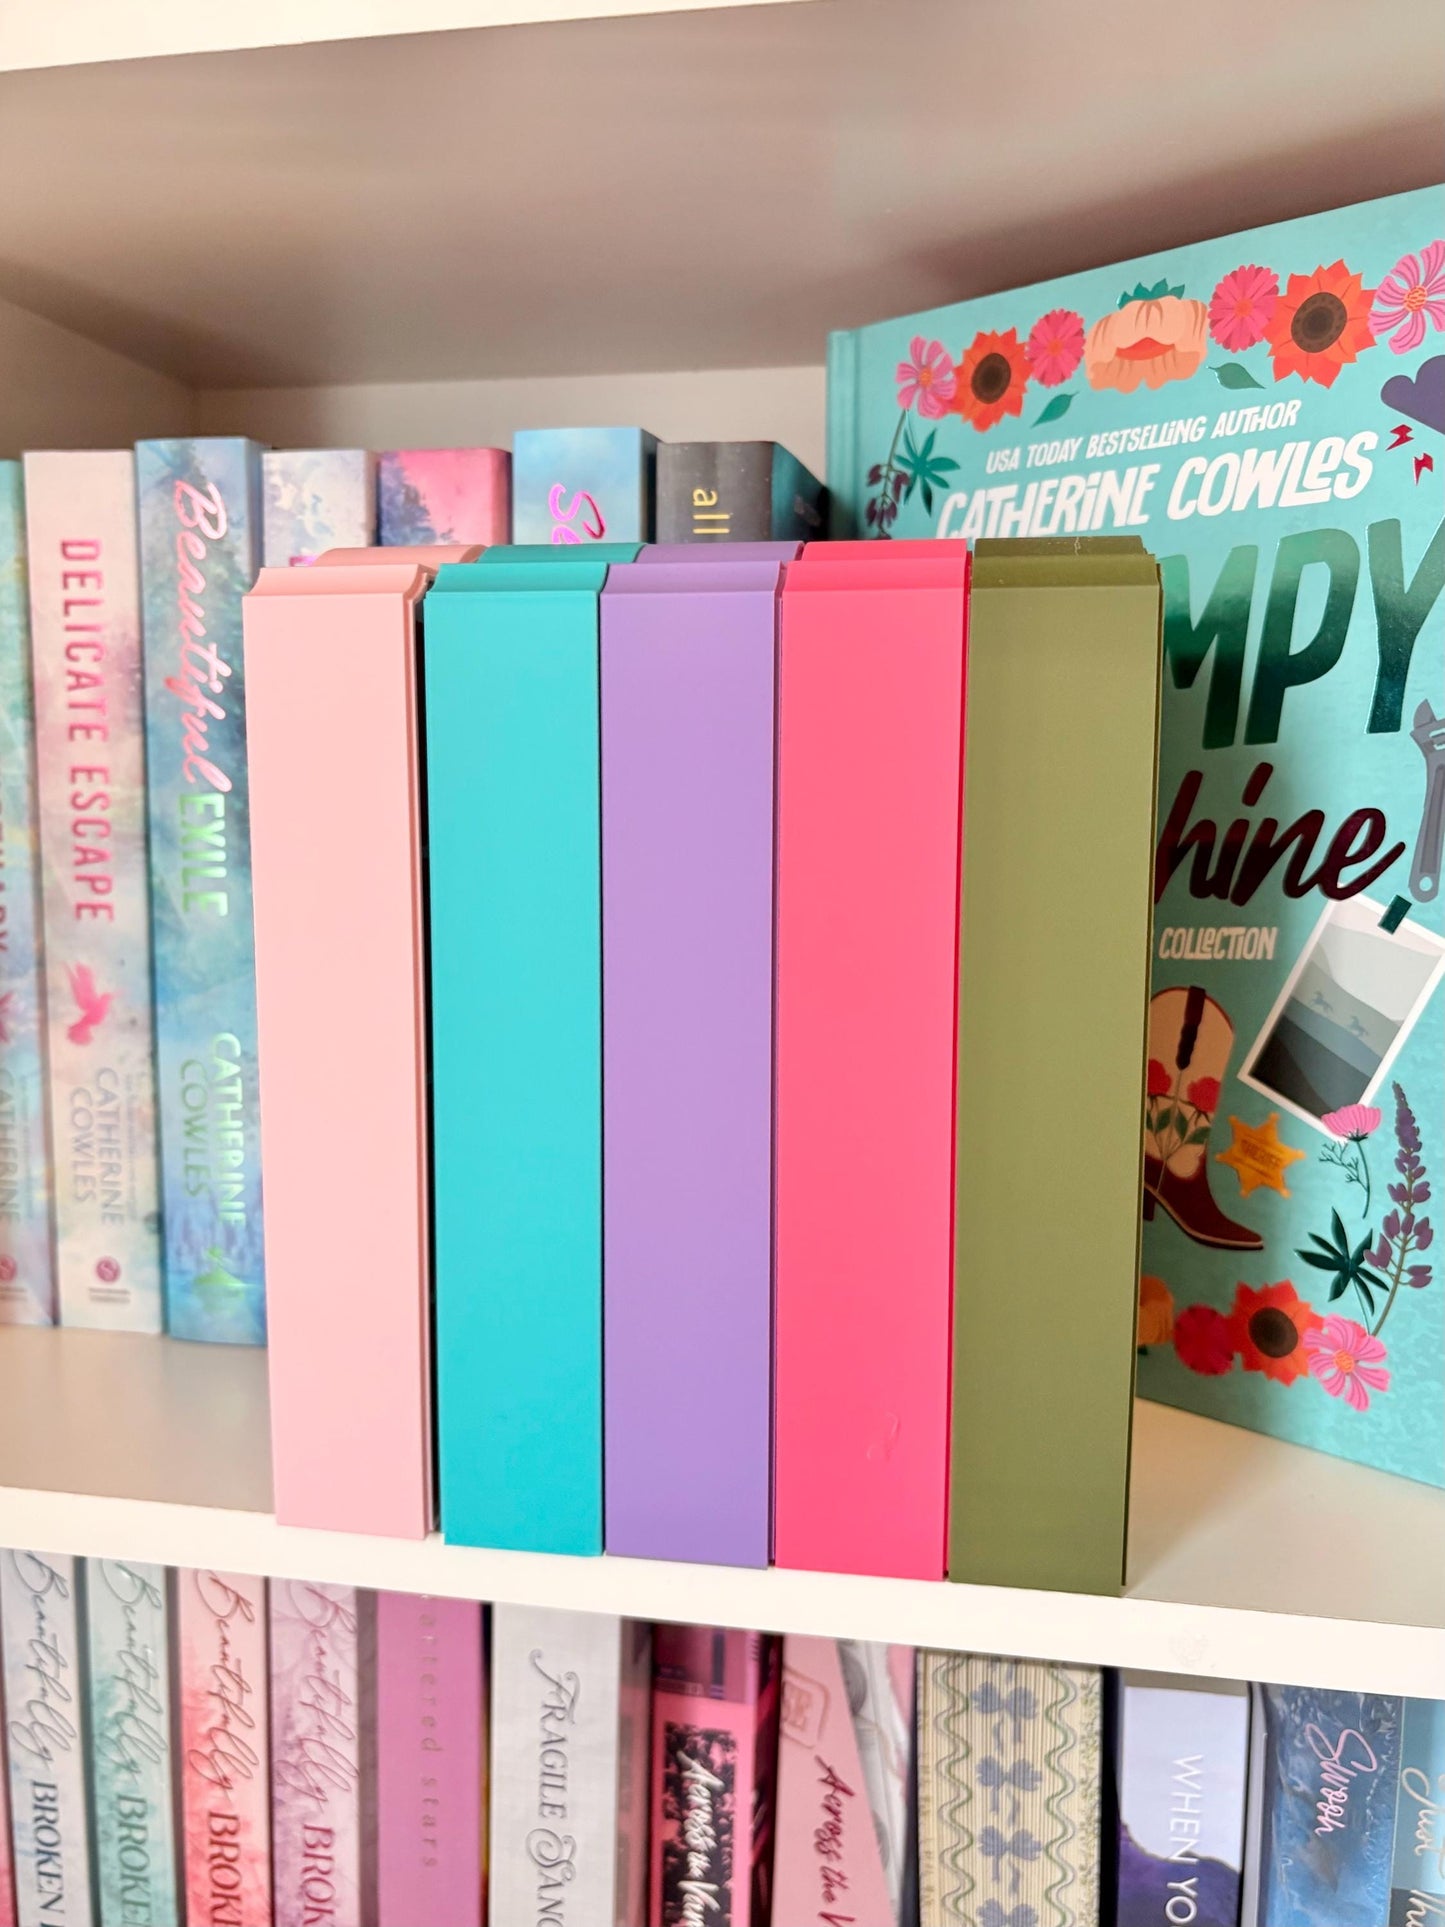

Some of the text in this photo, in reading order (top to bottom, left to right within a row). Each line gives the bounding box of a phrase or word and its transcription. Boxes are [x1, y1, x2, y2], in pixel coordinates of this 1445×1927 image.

[985, 446, 1021, 474] USA
[1026, 436, 1084, 469] TODAY
[1210, 399, 1303, 440] AUTHOR
[164, 480, 233, 917] Beautiful EXILE
[1161, 516, 1445, 750] MPY
[60, 539, 115, 923] DELICATE ESCAPE
[1155, 761, 1406, 907] hine
[70, 1084, 97, 1205] COWLES
[95, 1066, 125, 1227] CATHERINE
[180, 1058, 210, 1198] COWLES
[211, 1032, 247, 1228] CATHERINE
[10, 1550, 77, 1768] Beautifully
[97, 1558, 168, 1927] Beautifully BROKE
[273, 1581, 360, 1812] Beautifully
[529, 1648, 581, 1819] FRAGILE
[187, 1568, 259, 1927] Beautifully BROK
[813, 1754, 856, 1862] Across
[1304, 1723, 1378, 1837] Swoon
[32, 1780, 65, 1915] BROKEN
[819, 1865, 851, 1903] the
[1165, 1754, 1205, 1927] WHEN YO
